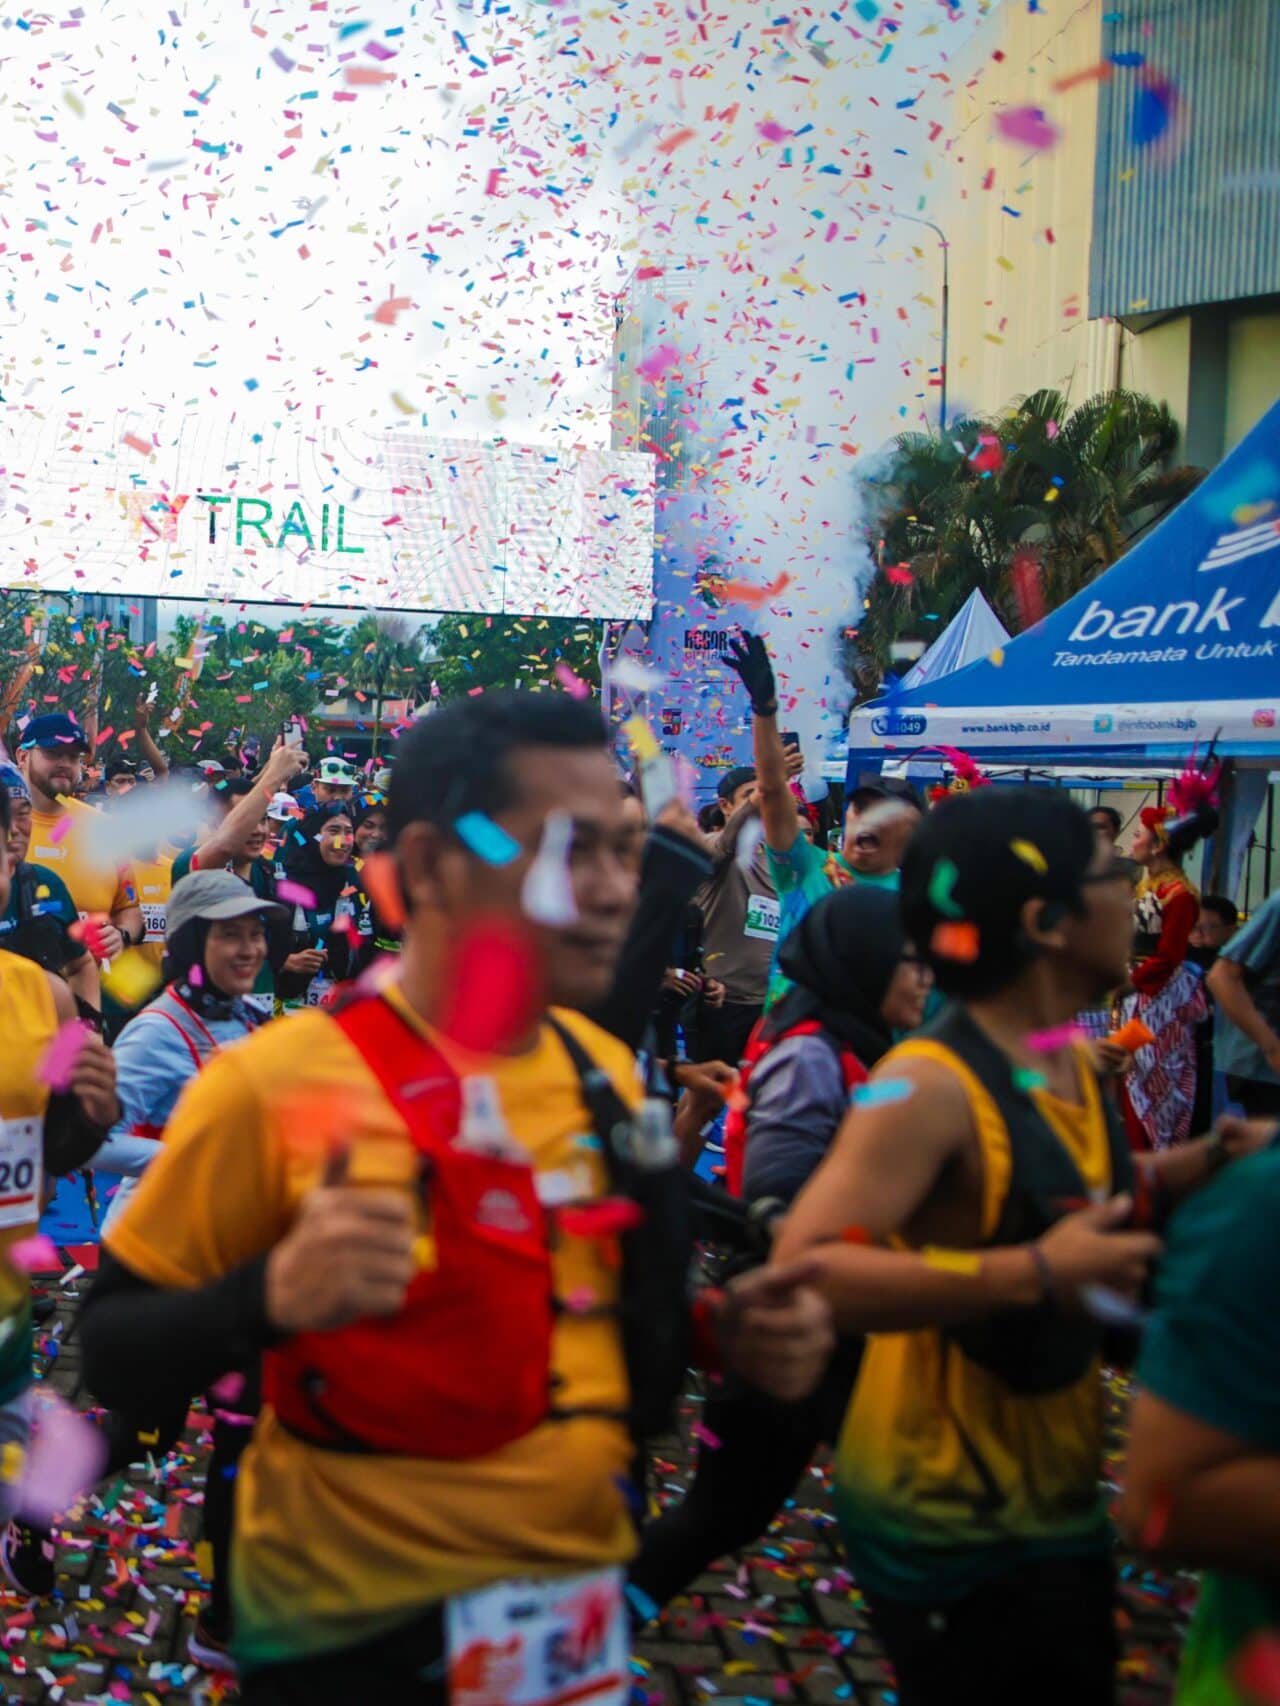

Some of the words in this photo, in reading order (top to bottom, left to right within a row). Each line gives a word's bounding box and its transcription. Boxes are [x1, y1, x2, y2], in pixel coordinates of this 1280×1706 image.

[196, 495, 364, 553] TRAIL
[1068, 587, 1246, 642] bank
[1052, 648, 1187, 667] Tandamata
[1195, 640, 1278, 660] Untuk
[961, 722, 1051, 733] www.bankbjb.co.id
